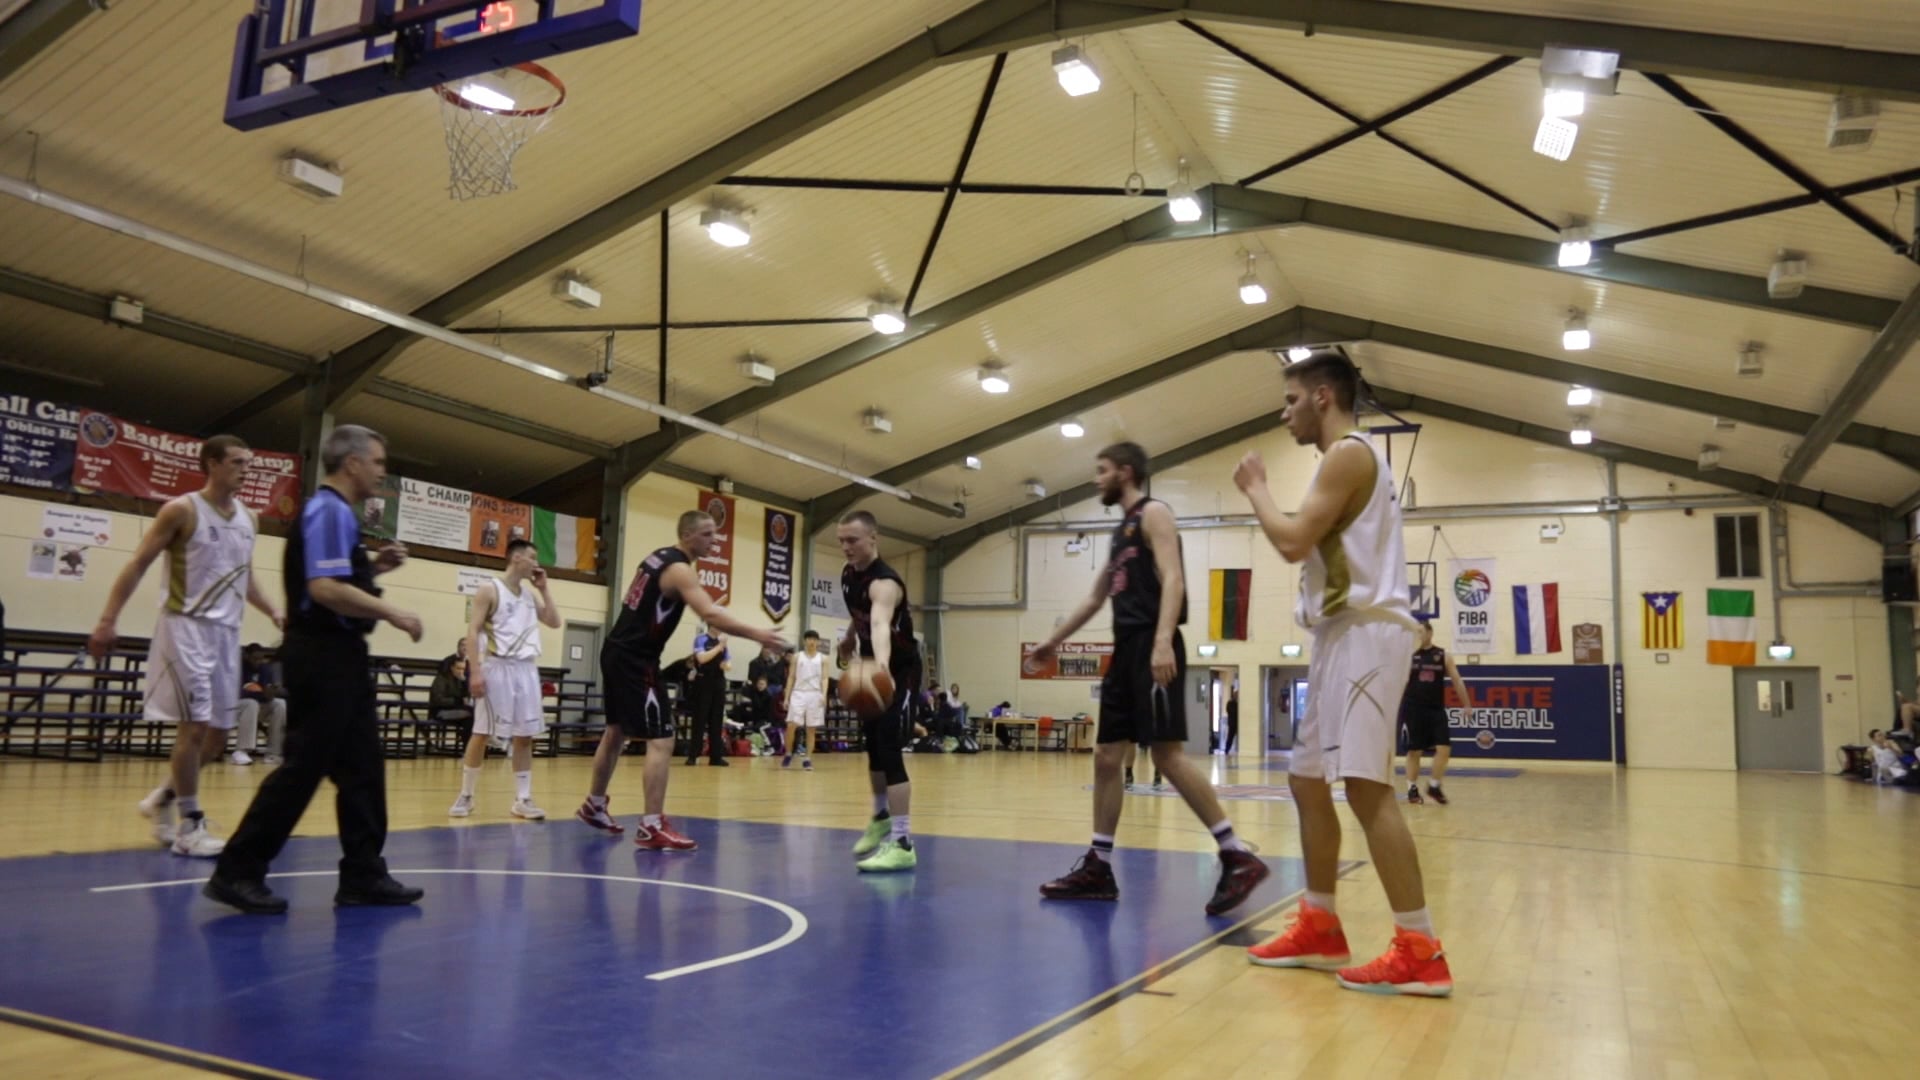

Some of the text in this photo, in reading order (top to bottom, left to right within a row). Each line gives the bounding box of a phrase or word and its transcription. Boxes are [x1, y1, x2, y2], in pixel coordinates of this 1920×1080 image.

[6, 420, 55, 437] Oblate
[247, 456, 294, 474] amp
[427, 486, 498, 510] CHAMPIONS
[698, 569, 728, 591] 2013
[811, 578, 832, 594] LATE
[764, 581, 789, 600] 2015
[1458, 611, 1488, 625] FIBA
